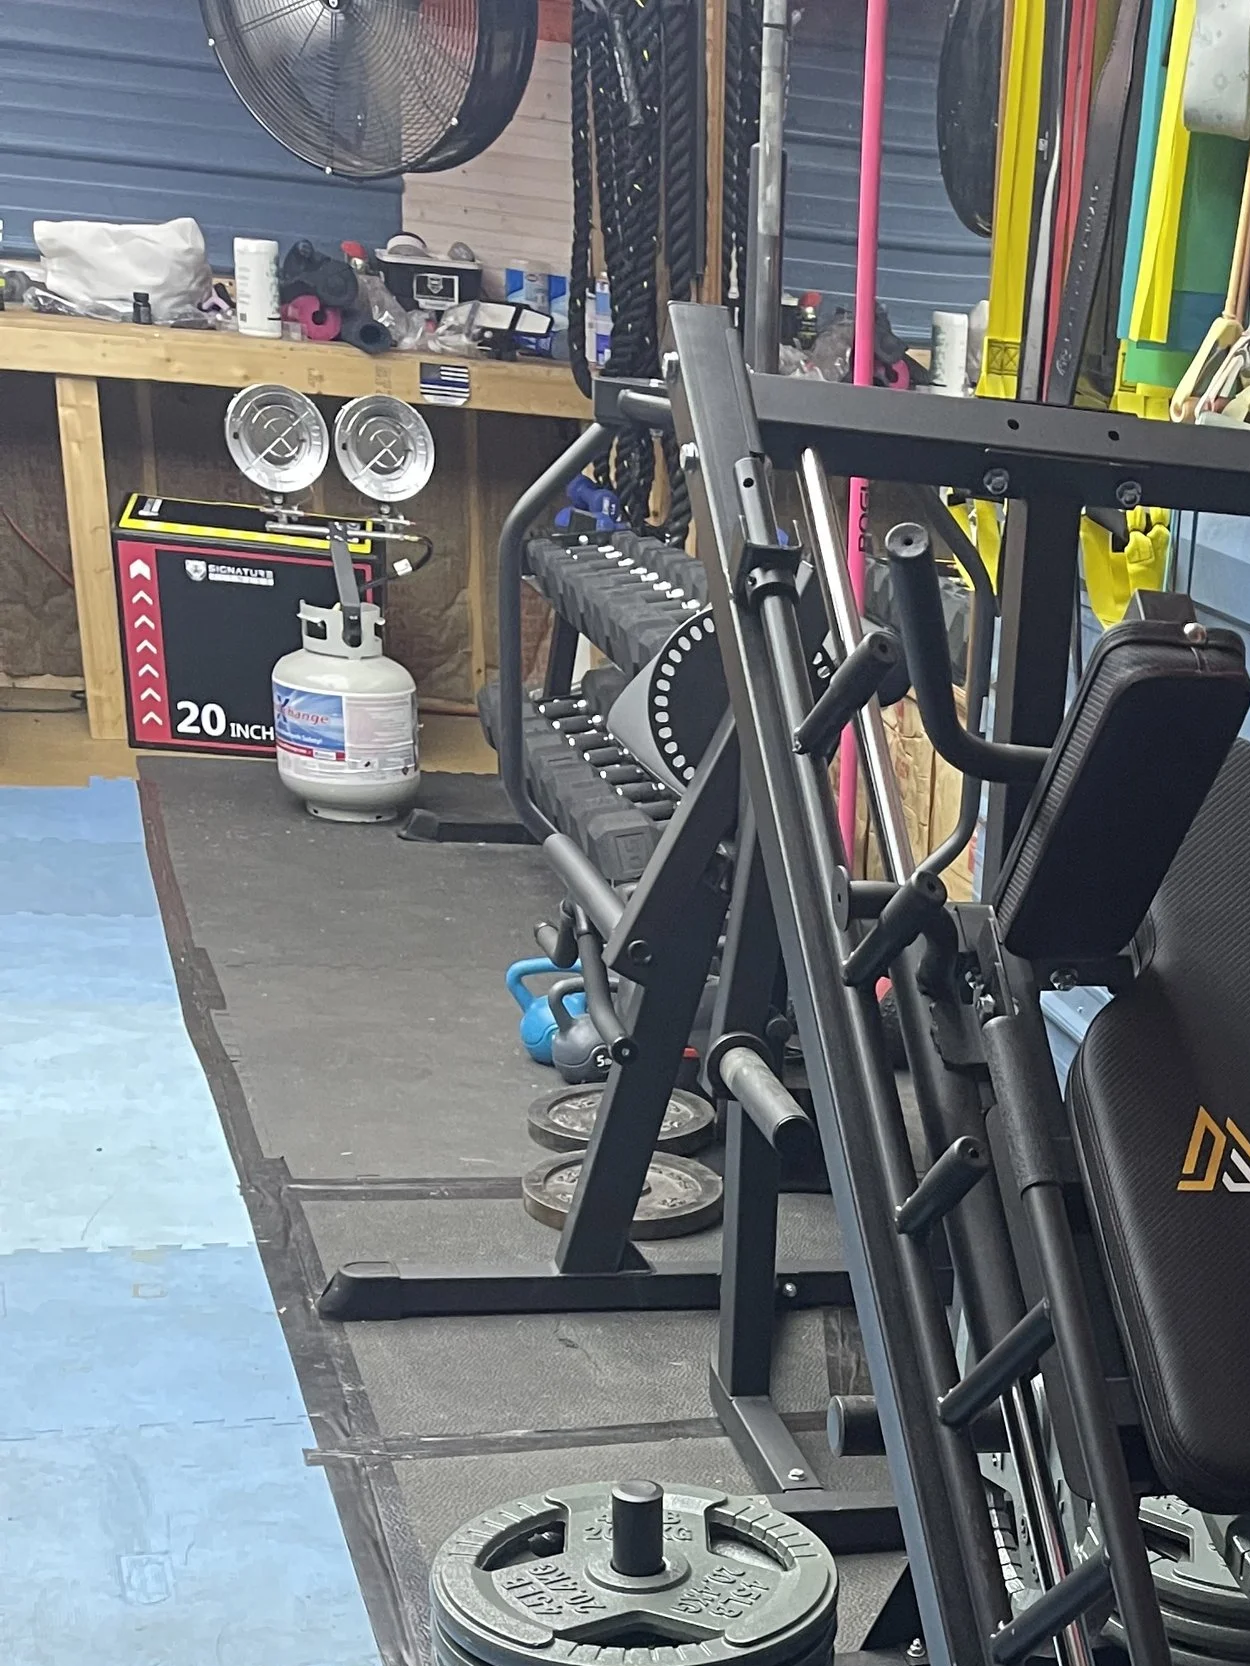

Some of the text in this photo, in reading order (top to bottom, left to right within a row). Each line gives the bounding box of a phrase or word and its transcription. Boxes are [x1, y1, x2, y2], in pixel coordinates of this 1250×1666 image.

[177, 700, 275, 741] 20 INCH
[500, 1577, 564, 1616] 45LB
[710, 1579, 770, 1619] 45LB
